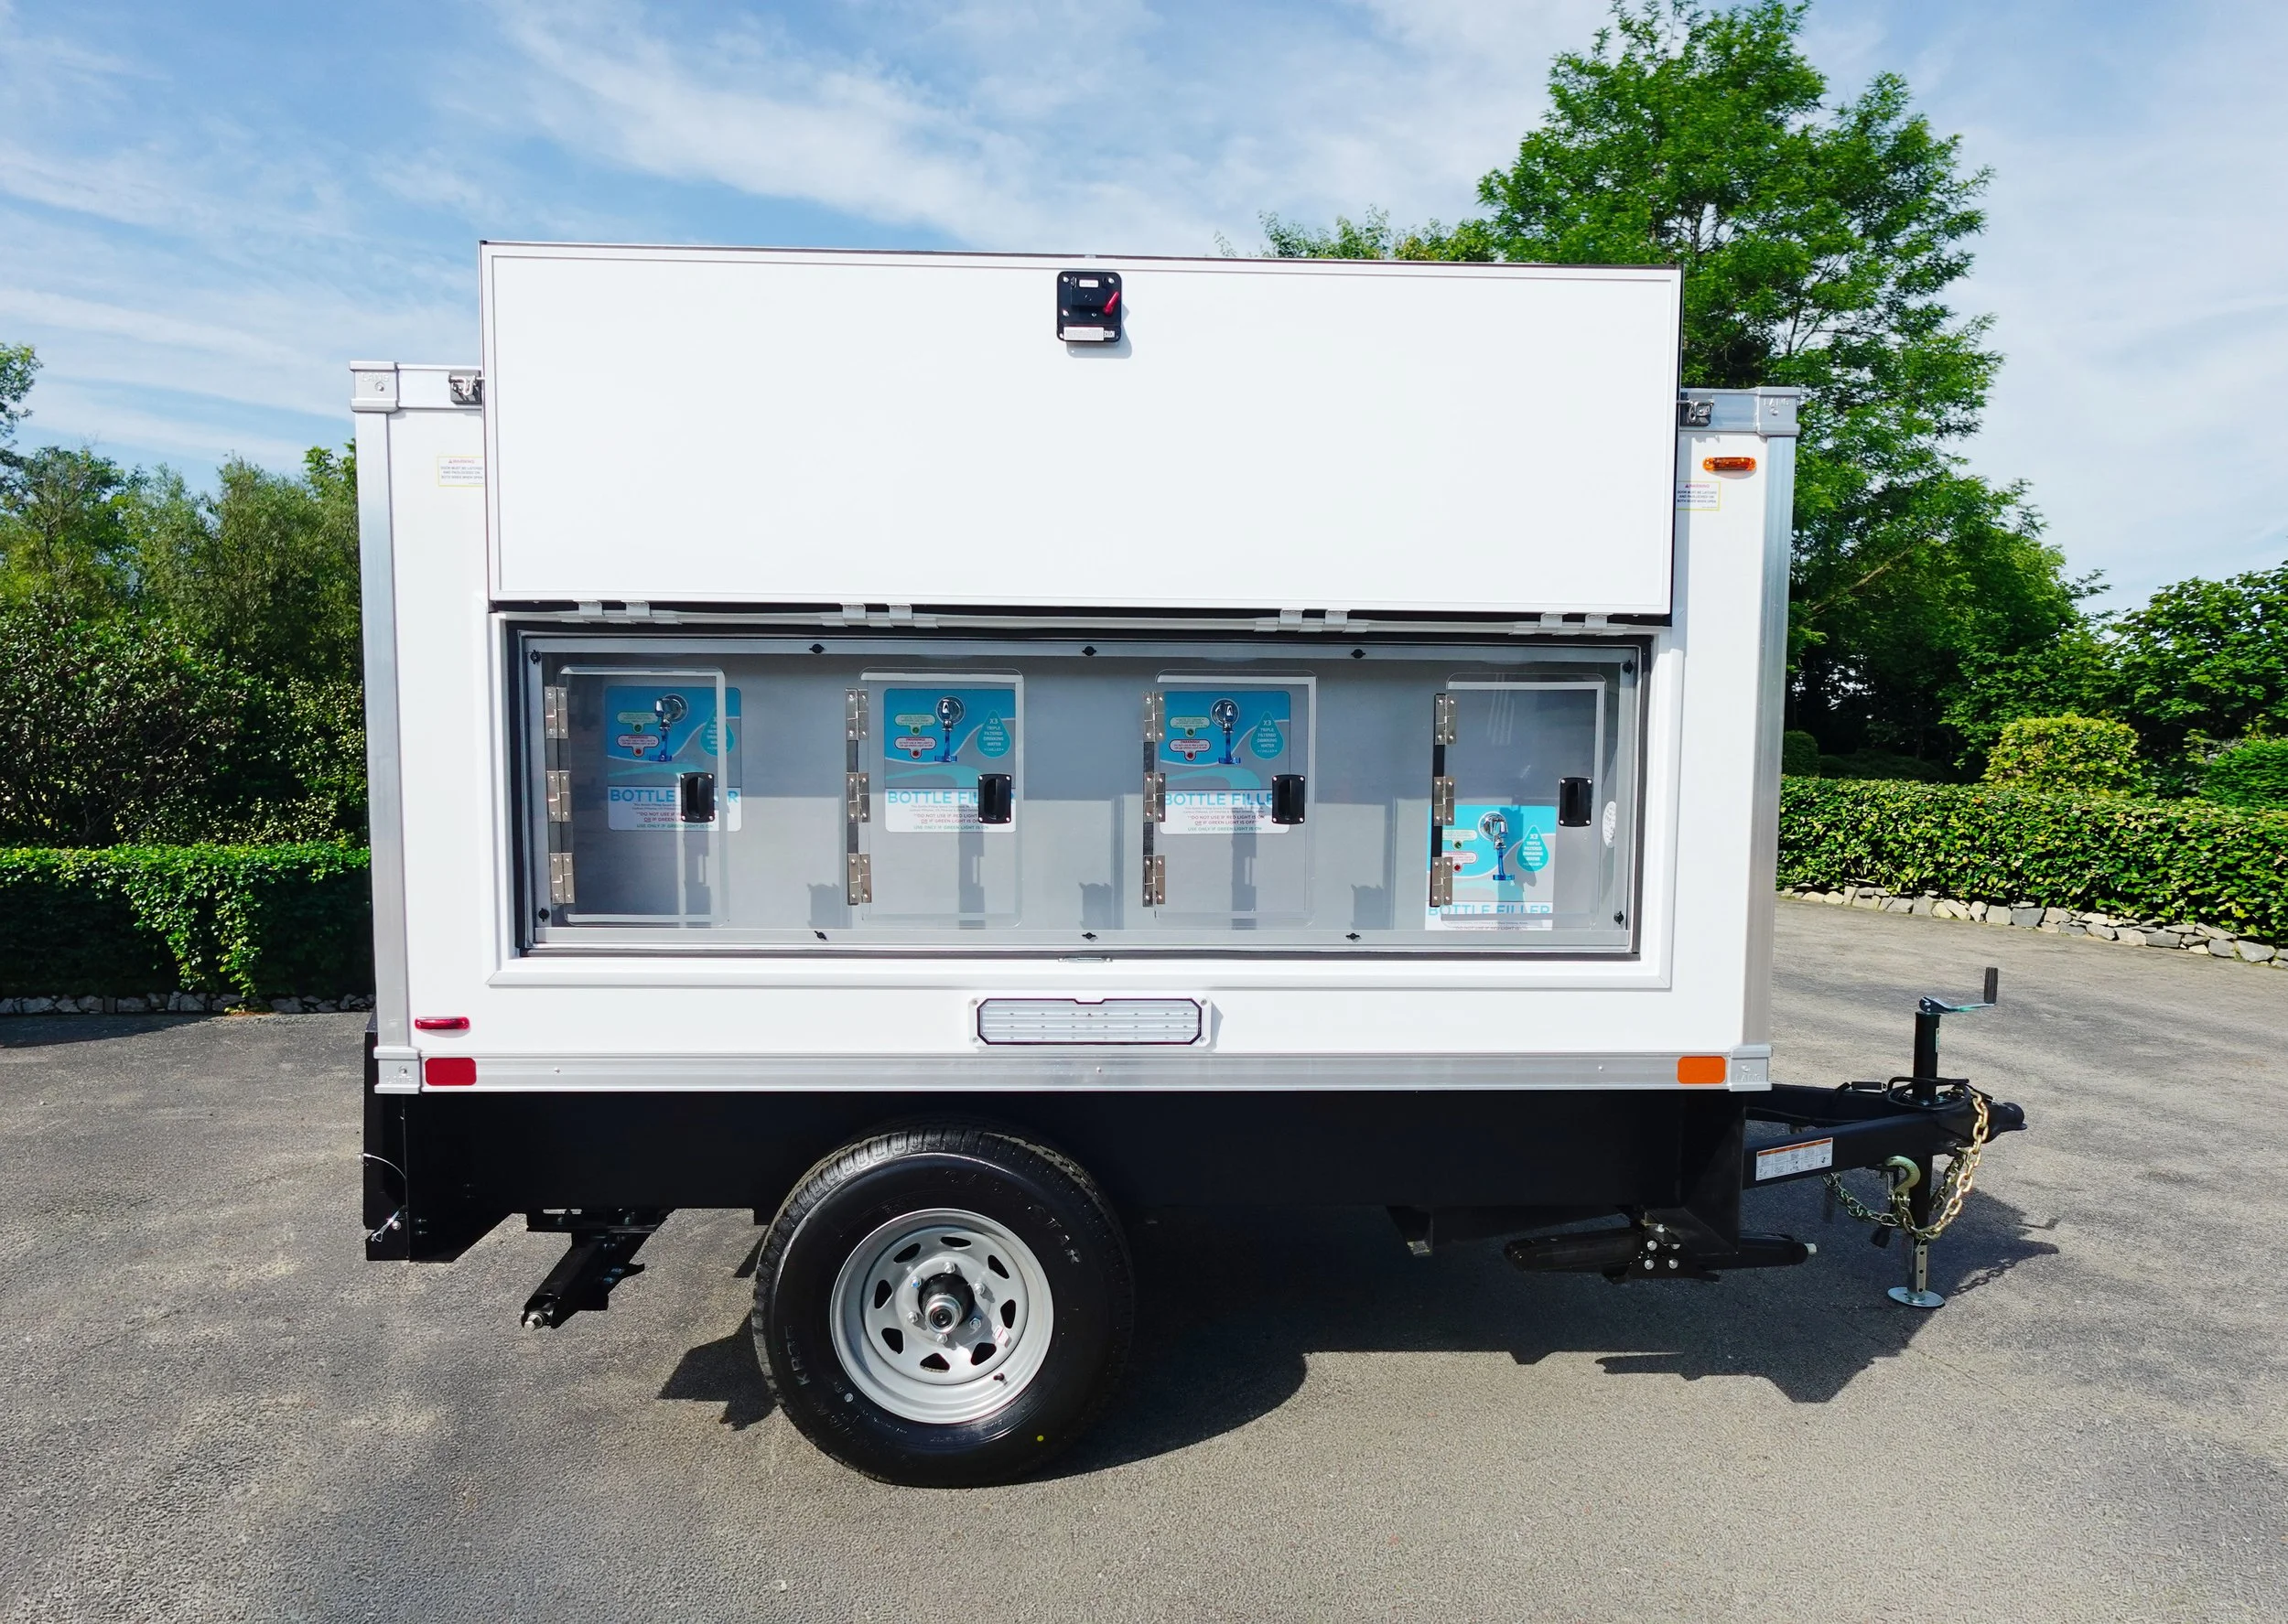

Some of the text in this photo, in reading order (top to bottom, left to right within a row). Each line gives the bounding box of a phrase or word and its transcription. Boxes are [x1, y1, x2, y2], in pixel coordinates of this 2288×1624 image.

[610, 790, 675, 802] BOTTLE
[888, 791, 952, 803] BOTTLE
[1165, 793, 1272, 805] BOTTLE FILLE
